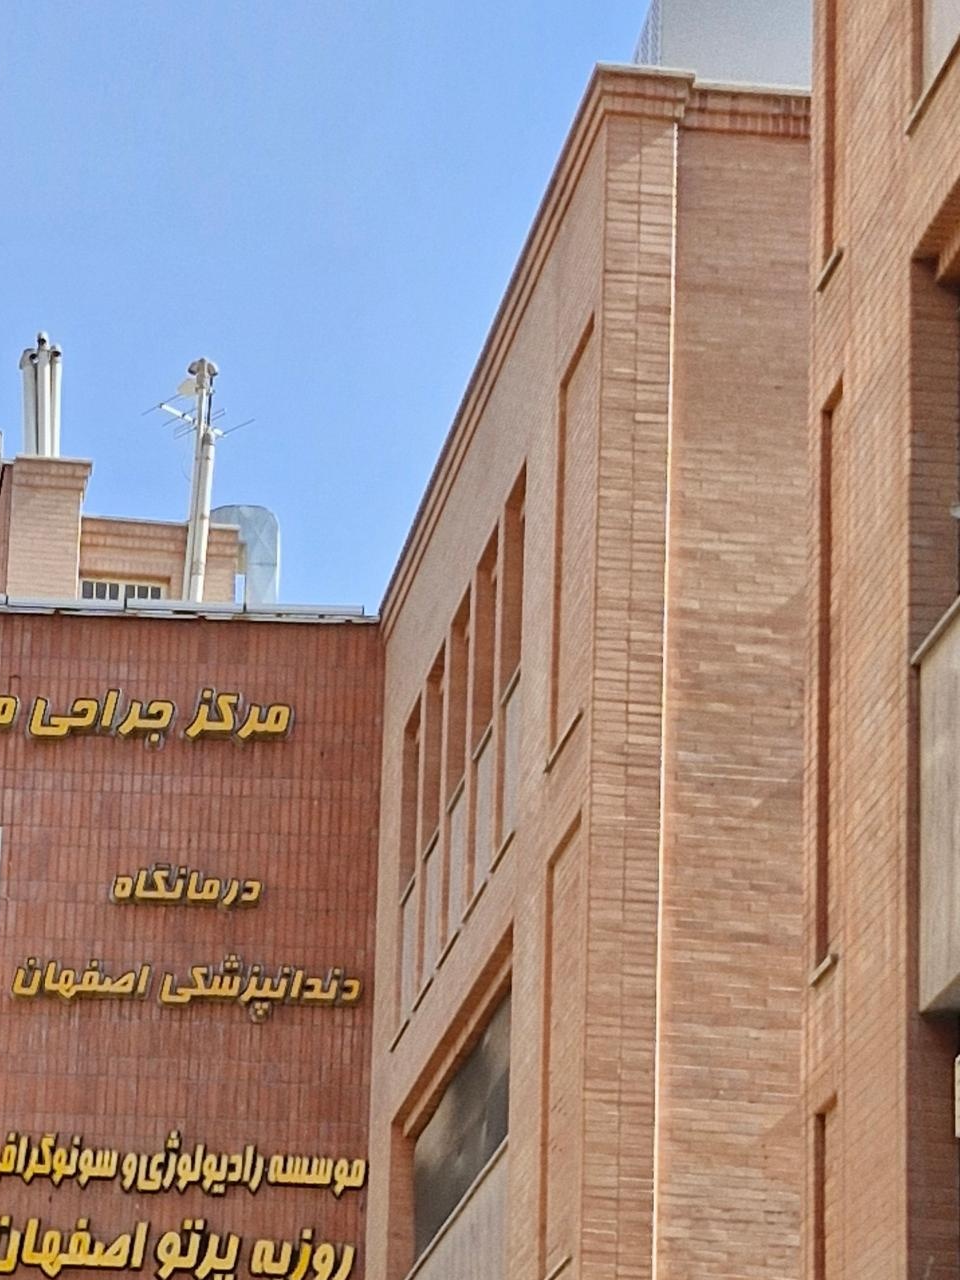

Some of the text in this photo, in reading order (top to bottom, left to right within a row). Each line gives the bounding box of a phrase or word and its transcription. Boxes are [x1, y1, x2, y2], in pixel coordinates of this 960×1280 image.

[28, 689, 173, 748] جراحی
[184, 688, 292, 744] مرکز
[112, 863, 264, 910] درمانگاه
[10, 953, 362, 1021] دندانپزشکی اصفهان
[122, 1158, 136, 1189] و
[137, 1130, 266, 1194] رادیولوژی
[268, 1157, 367, 1196] موسسه
